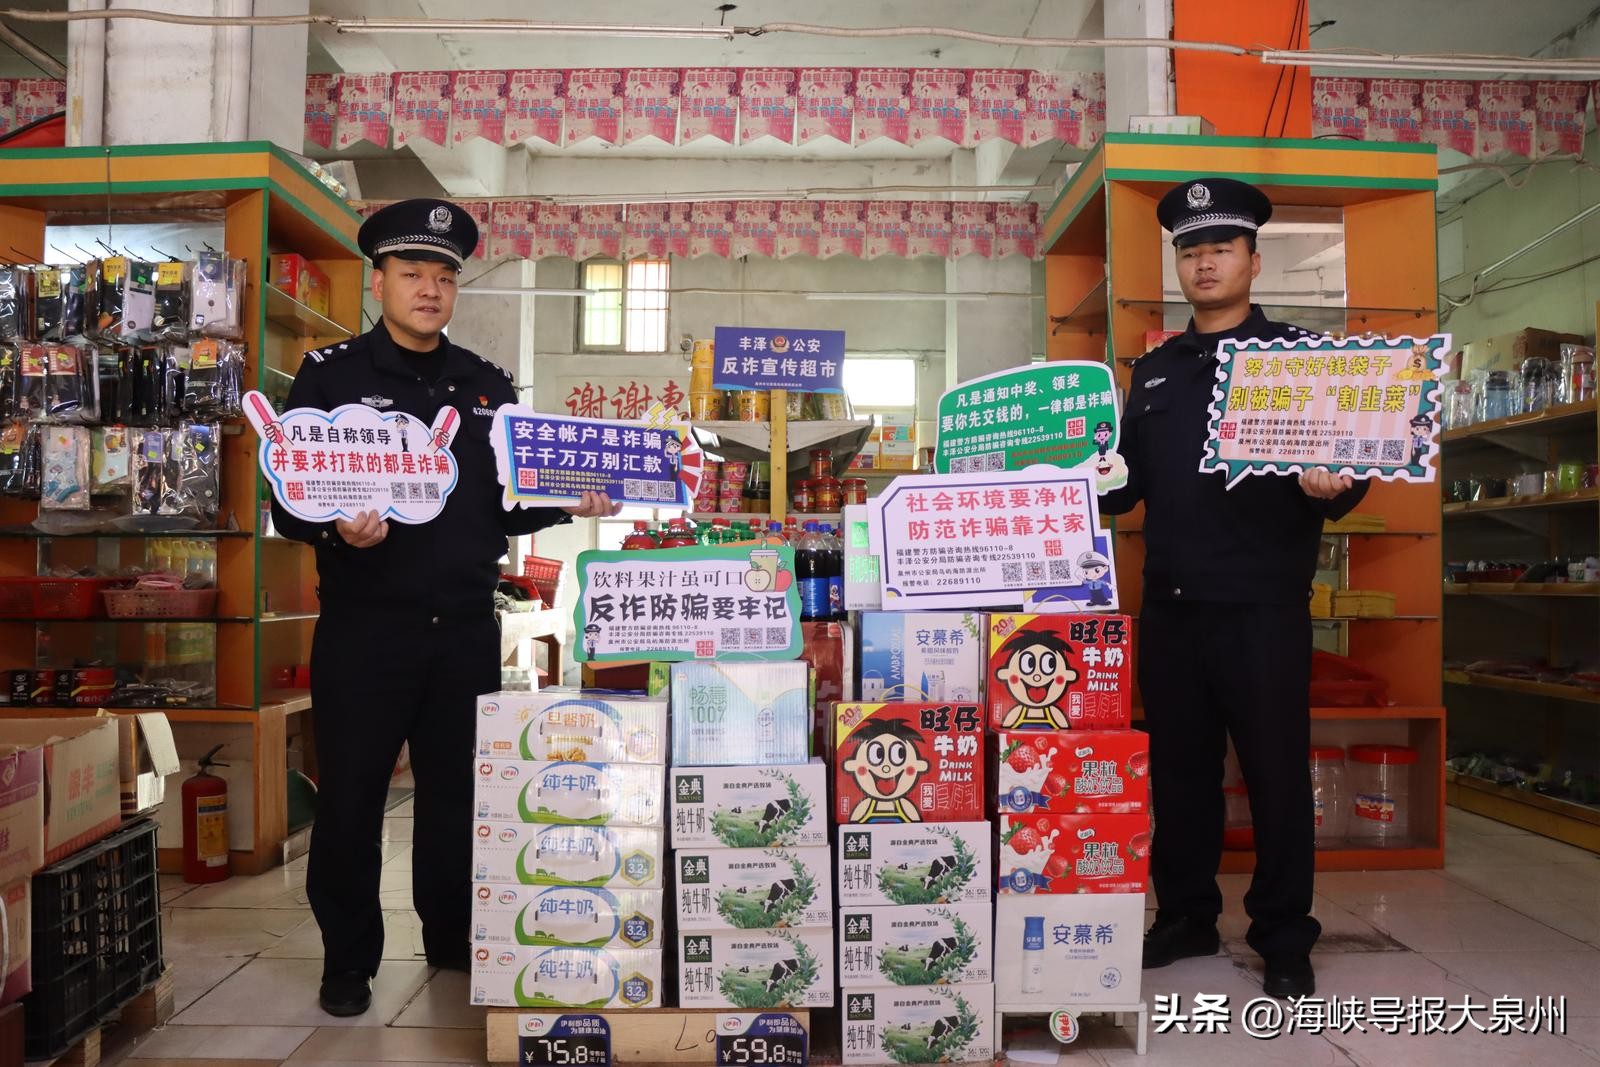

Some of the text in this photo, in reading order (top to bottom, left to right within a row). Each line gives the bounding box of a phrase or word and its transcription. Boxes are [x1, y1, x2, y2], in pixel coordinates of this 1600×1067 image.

[739, 336, 821, 352] 丰泽 公安
[722, 356, 837, 378] 反诈宣传超市
[1244, 356, 1392, 377] 努力守好钱袋子
[565, 380, 688, 420] 谢谢惠
[956, 373, 1080, 408] 凡是通知中奖、领奖
[291, 425, 392, 445] 凡是自称领导
[514, 421, 662, 450] 安全帐户是诈骗
[272, 449, 450, 475] 并要求打款的都是诈骗
[514, 445, 662, 473] 千千万万别汇款
[906, 485, 1083, 514] 社会环境要净化
[908, 512, 1086, 541] 防范诈骗靠大家
[593, 570, 742, 589] 饮料果汁虽可口
[589, 593, 787, 622] 反诈防骗要牢记
[916, 629, 964, 646] 安慕希
[1070, 619, 1127, 644] 旺仔
[1082, 647, 1124, 667] 牛奶
[1087, 670, 1119, 679] DRINK
[1087, 682, 1118, 691] MILK
[920, 706, 981, 732] 旺仔
[934, 735, 978, 756] 牛奶
[939, 759, 973, 770] DRINK
[1082, 760, 1117, 777] 果粒
[543, 773, 597, 791] 纯牛奶
[939, 770, 973, 782] MILK
[678, 778, 702, 796] 金典
[676, 807, 706, 834] 纯牛奶
[540, 836, 595, 856] 纯牛奶
[846, 834, 869, 852] 金典
[1084, 843, 1118, 859] 果粒
[683, 859, 708, 877] 金典
[843, 865, 872, 890] 纯牛奶
[540, 897, 594, 914] 纯牛奶
[682, 888, 711, 914] 纯牛奶
[847, 917, 870, 934] 金典
[1052, 924, 1114, 945] 安慕希
[686, 939, 710, 956] 金典
[844, 946, 873, 972] 纯牛奶
[539, 960, 594, 979] 纯牛奶
[684, 967, 713, 993] 纯牛奶
[849, 996, 873, 1013] 金典
[847, 1025, 876, 1050] 纯牛奶
